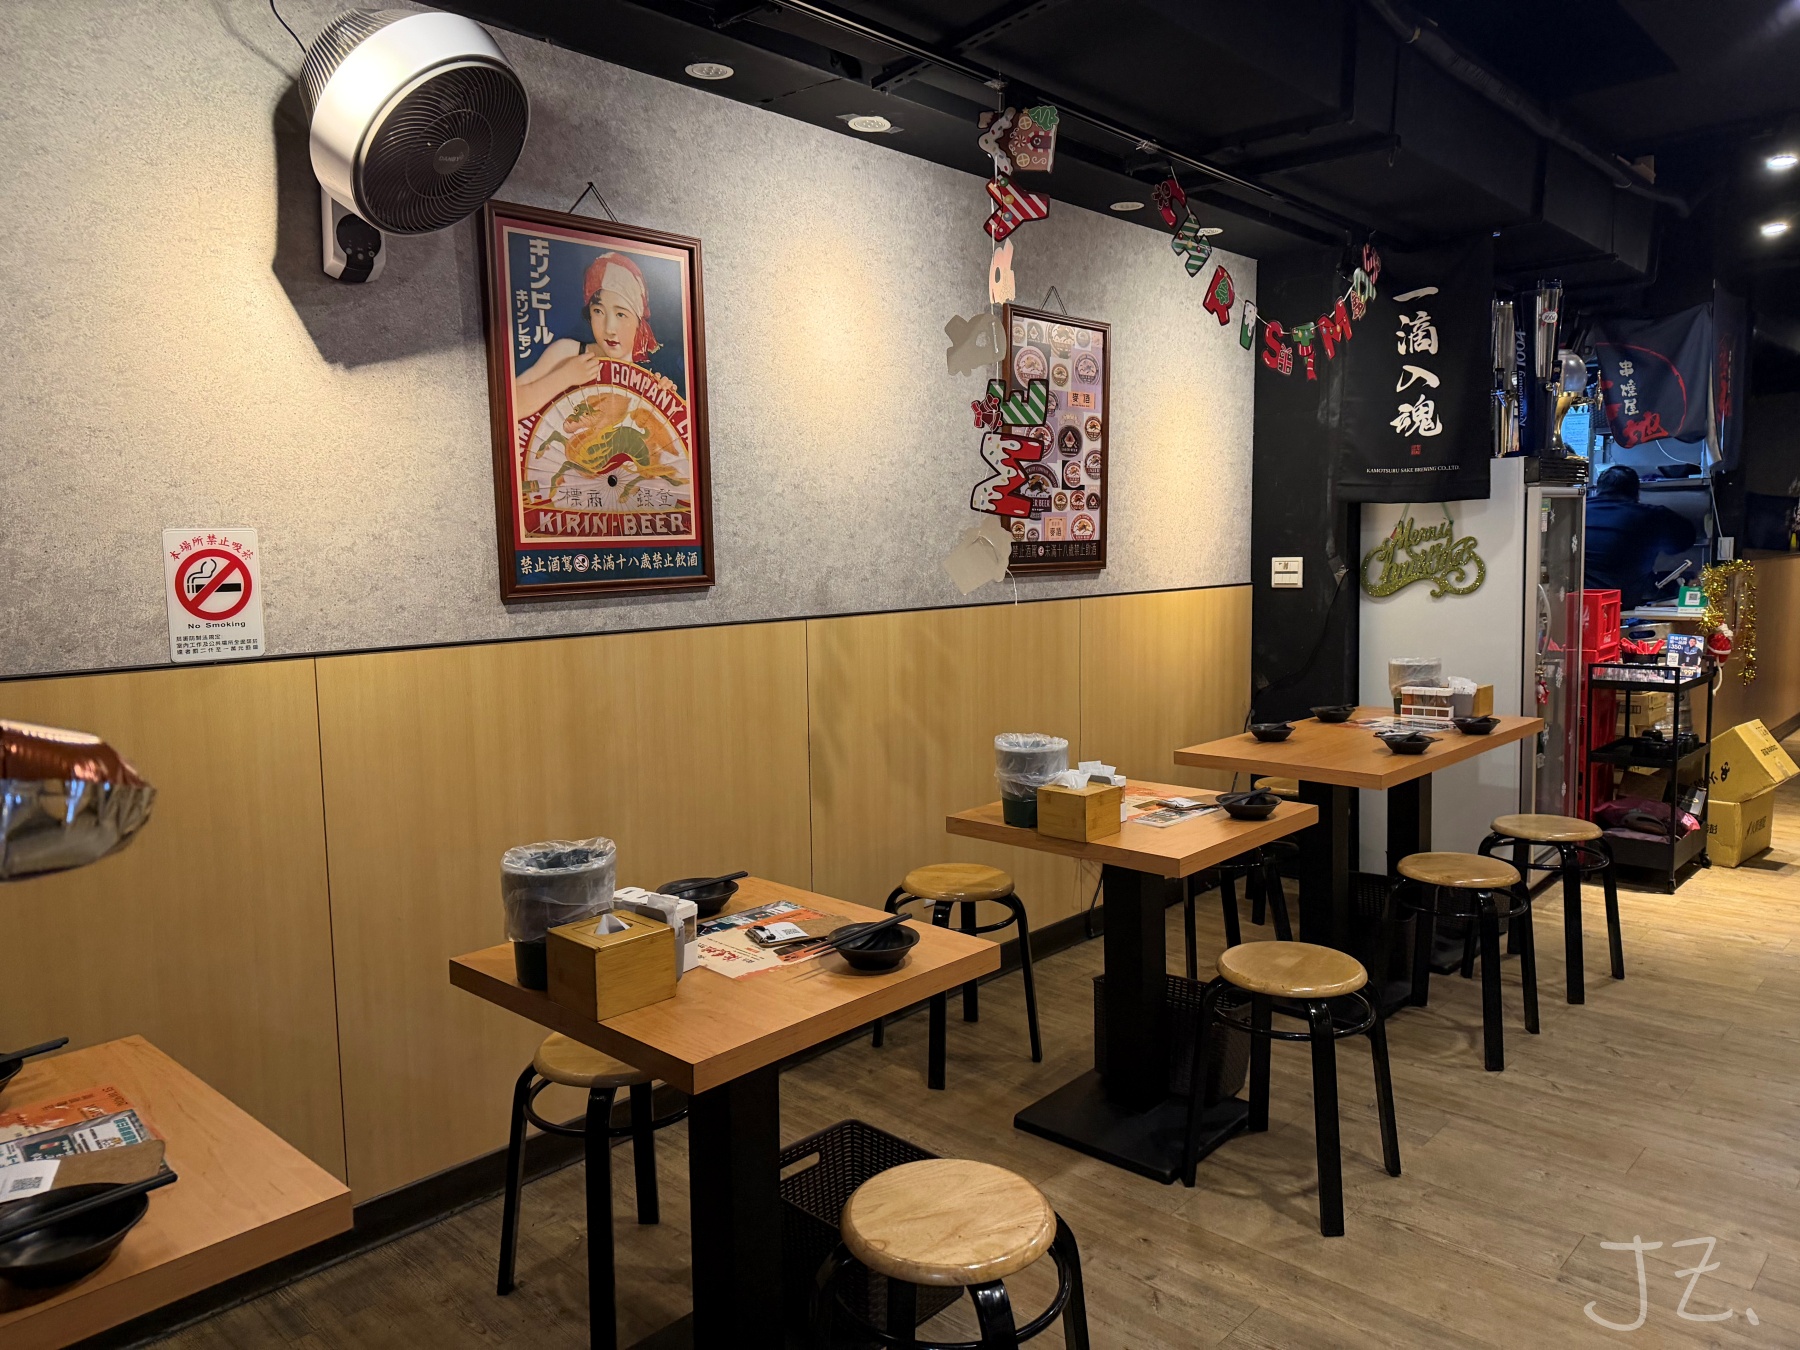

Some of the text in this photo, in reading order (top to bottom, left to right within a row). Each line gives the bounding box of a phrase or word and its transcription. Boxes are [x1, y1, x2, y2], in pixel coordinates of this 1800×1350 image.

[529, 238, 555, 345] キリンビール
[515, 289, 532, 359] キリンレモン
[1390, 286, 1443, 438] 一滴入魂
[1618, 359, 1640, 416] 串燒屋
[169, 533, 254, 562] 本場所禁止吸菸
[520, 554, 573, 575] 禁止酒駕
[205, 621, 246, 629] Smoking
